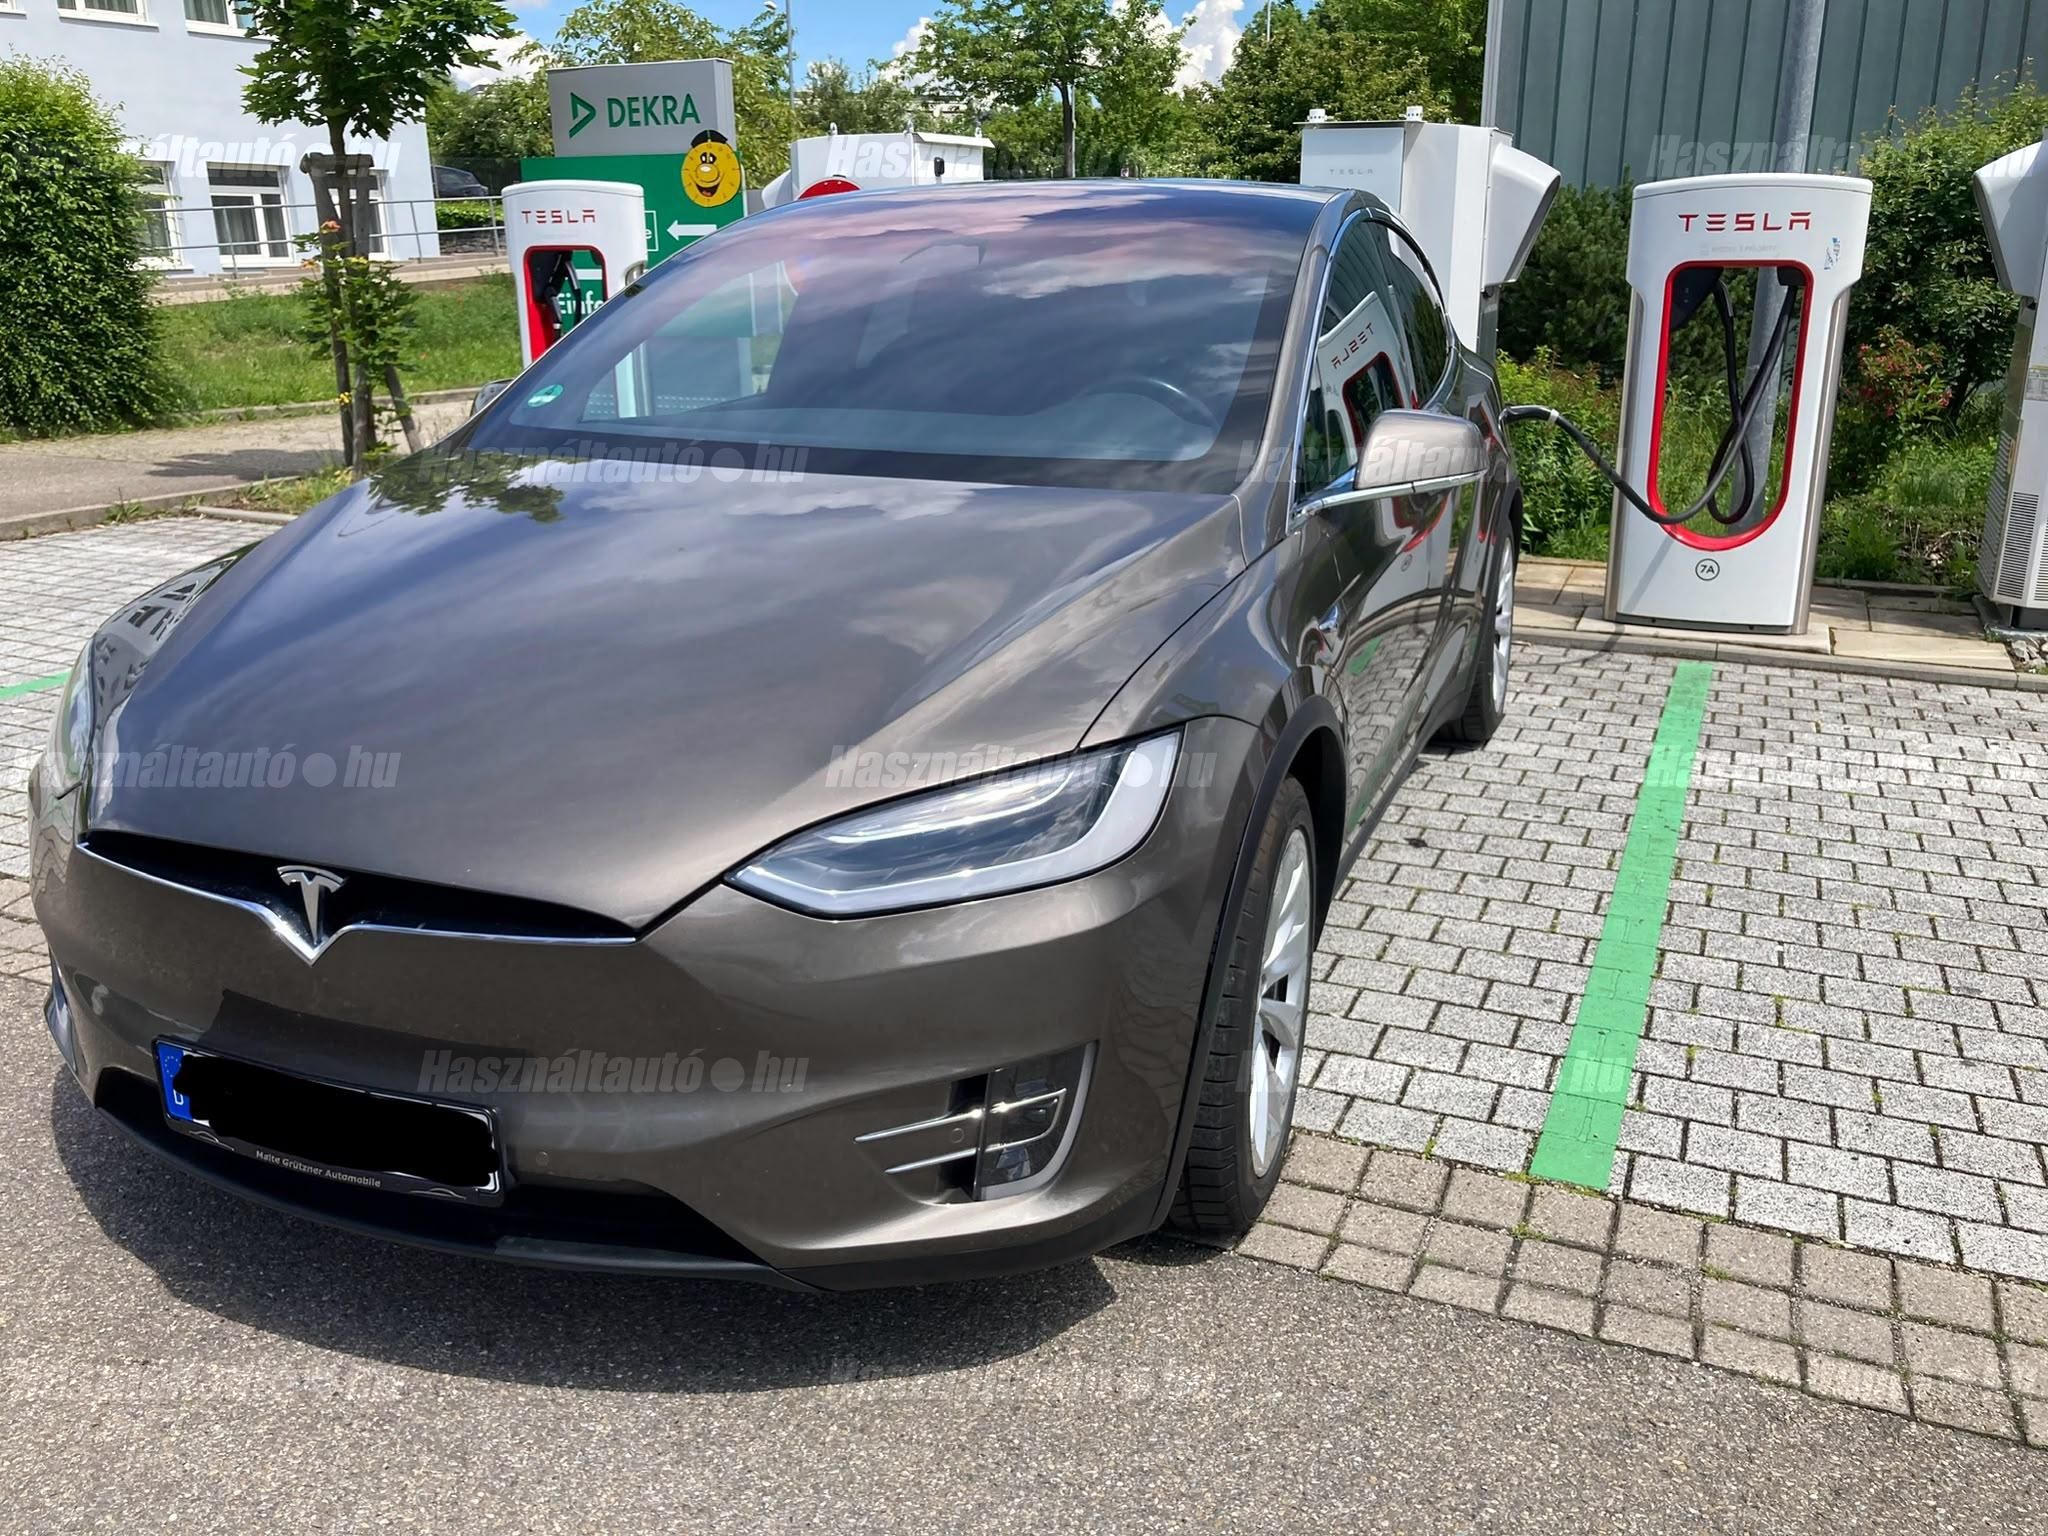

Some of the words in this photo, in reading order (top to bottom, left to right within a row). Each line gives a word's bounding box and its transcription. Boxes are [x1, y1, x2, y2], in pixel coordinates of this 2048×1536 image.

[607, 93, 701, 128] DEKRA
[521, 208, 596, 224] TESLA
[1678, 211, 1812, 232] TESLA
[1700, 564, 1715, 574] 7A
[325, 1171, 381, 1188] Automobile
